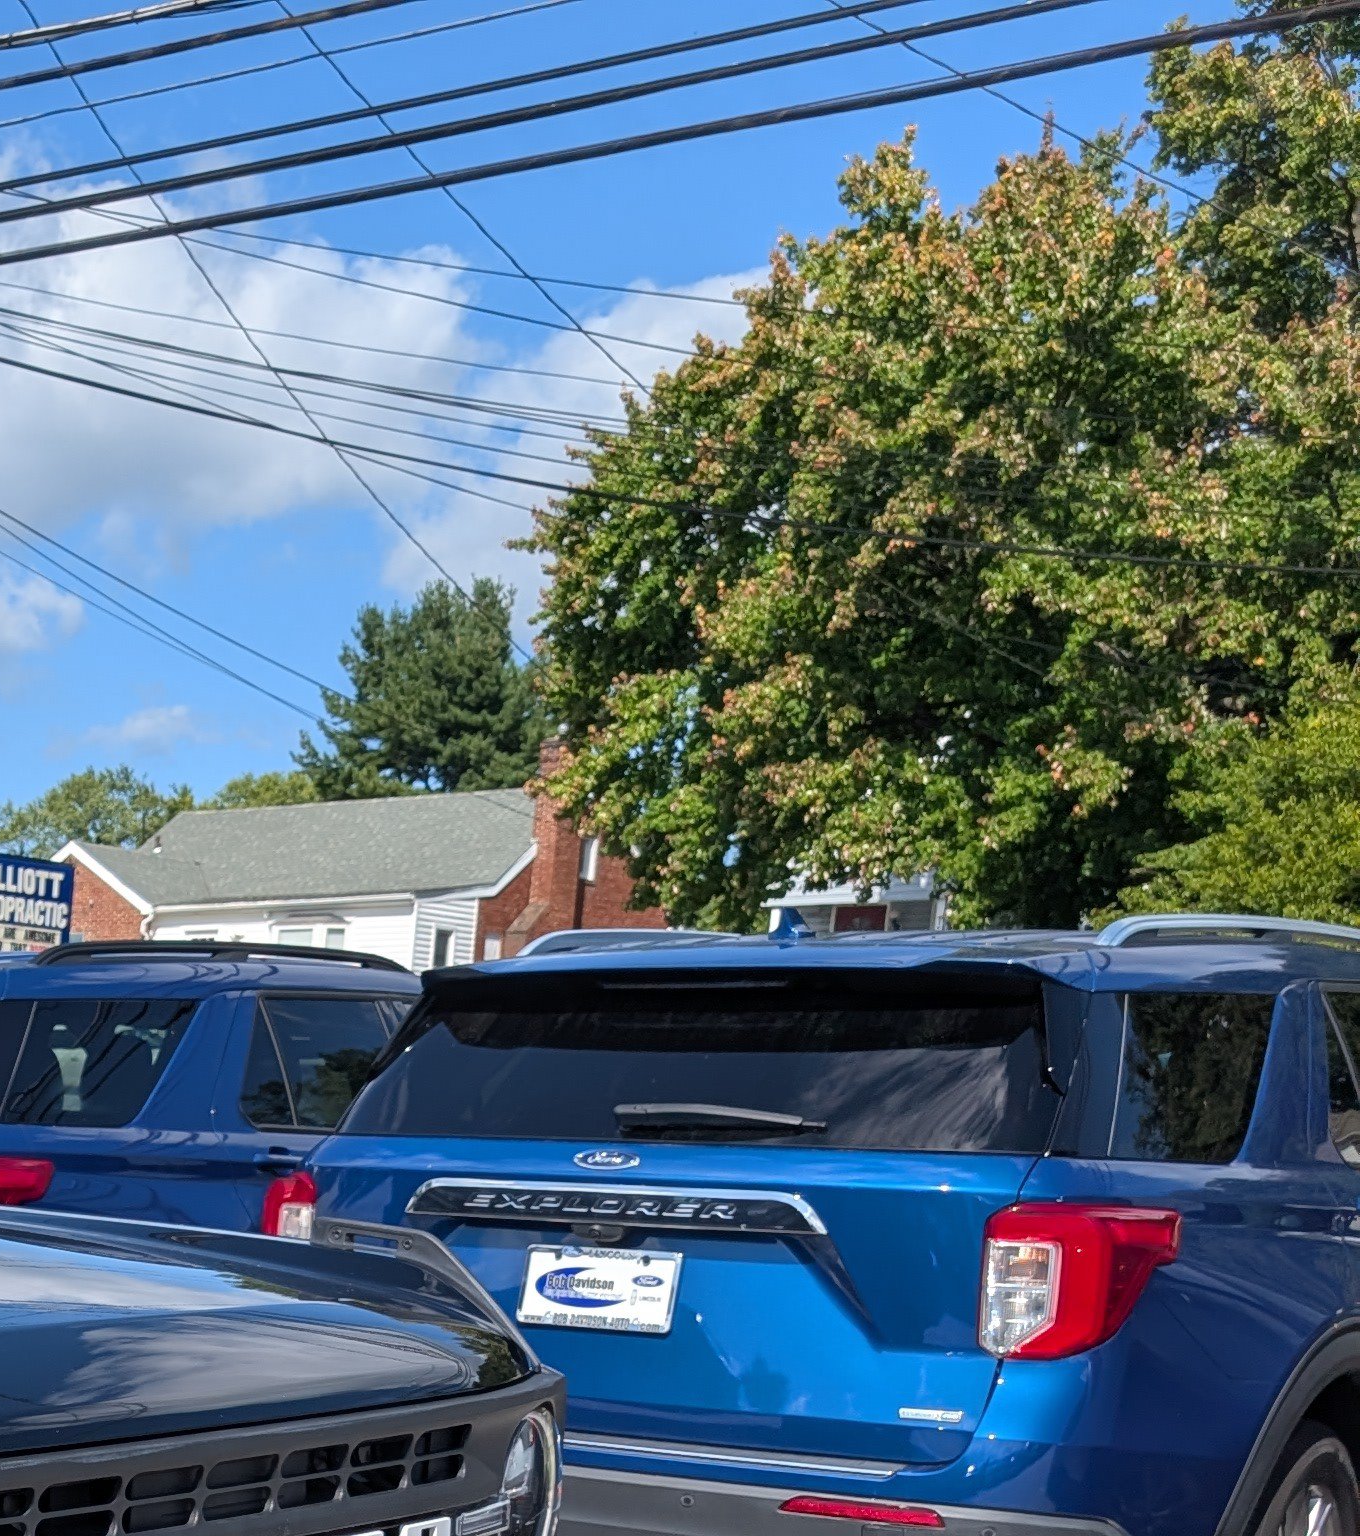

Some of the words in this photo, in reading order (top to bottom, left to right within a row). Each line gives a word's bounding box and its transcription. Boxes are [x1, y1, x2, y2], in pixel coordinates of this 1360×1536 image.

[463, 1193, 738, 1220] EXPLORER
[547, 1274, 568, 1289] Bob
[569, 1275, 615, 1291] Davidson
